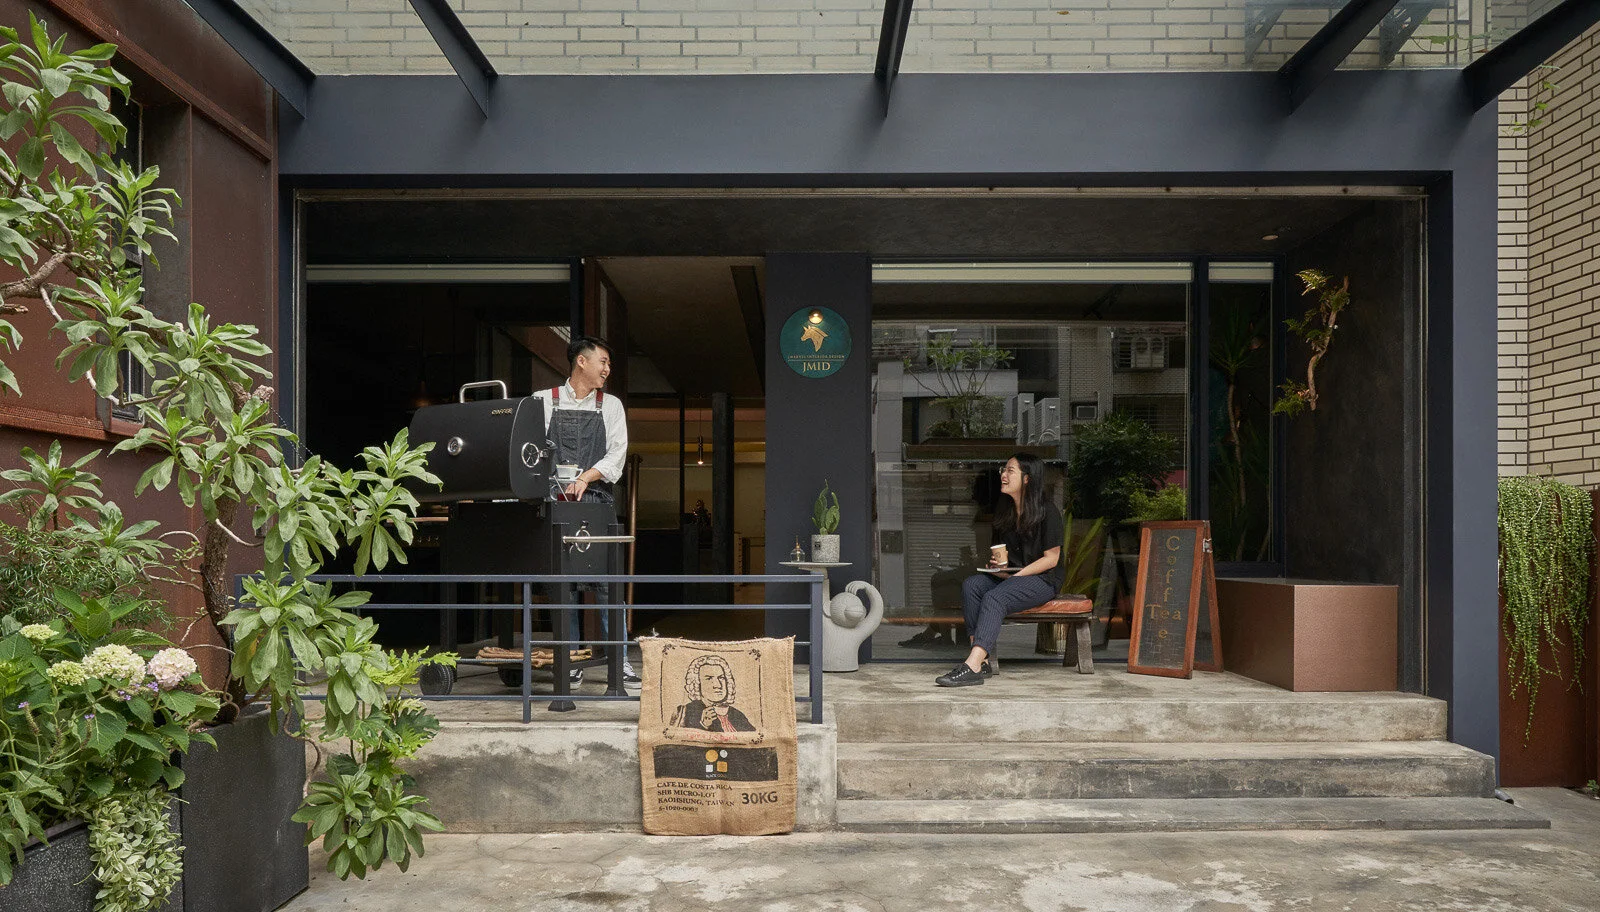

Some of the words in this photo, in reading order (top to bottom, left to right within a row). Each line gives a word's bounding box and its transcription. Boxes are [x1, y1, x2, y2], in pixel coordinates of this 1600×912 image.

[802, 361, 831, 373] JMID
[1146, 603, 1182, 620] Tea
[673, 789, 716, 798] MICRO-LOT
[741, 791, 778, 804] 30KG
